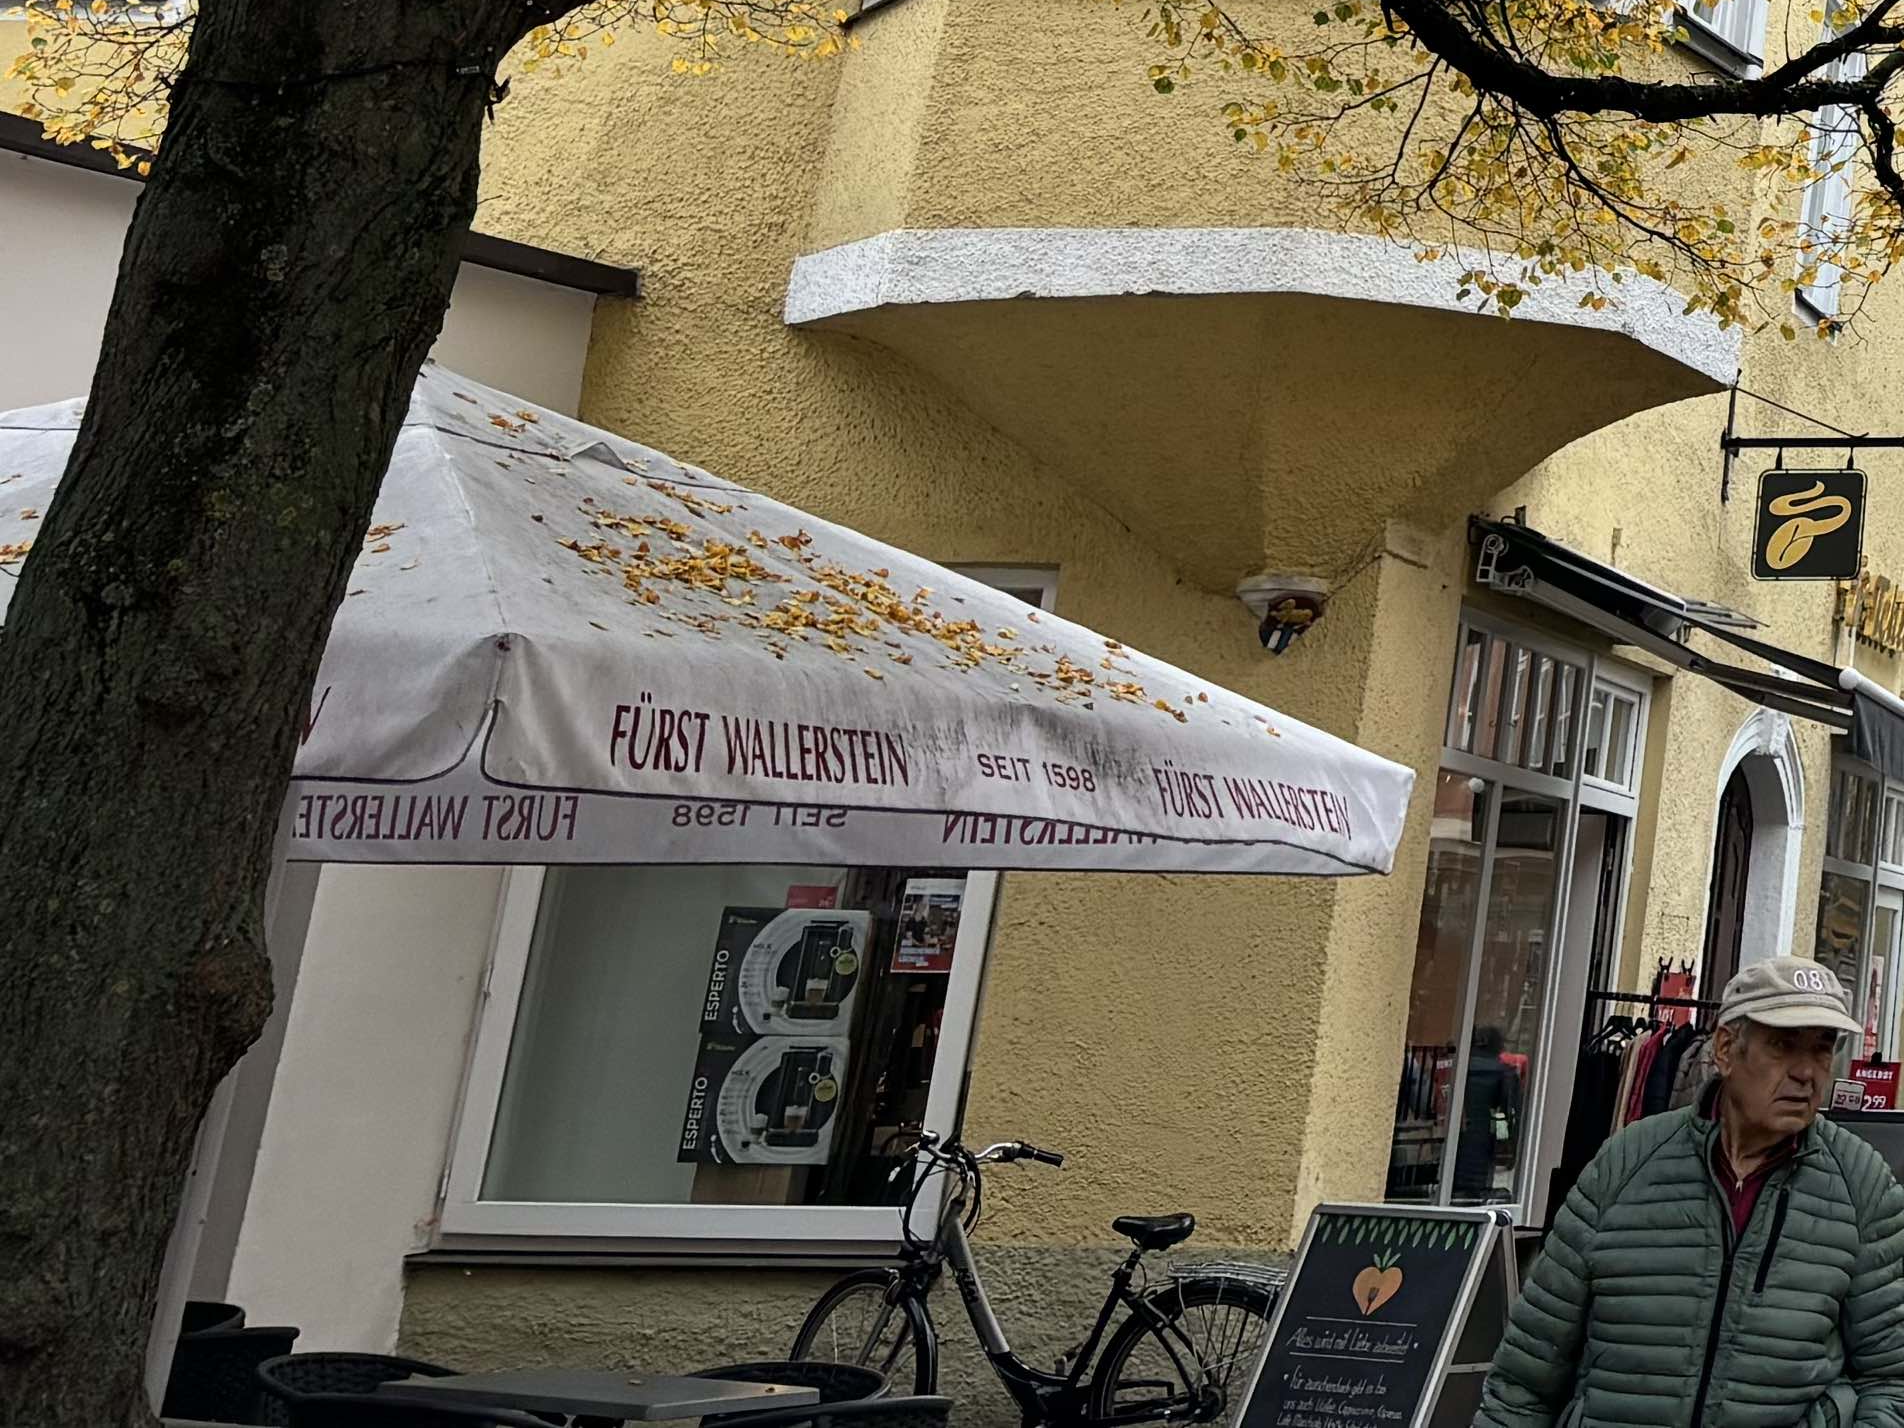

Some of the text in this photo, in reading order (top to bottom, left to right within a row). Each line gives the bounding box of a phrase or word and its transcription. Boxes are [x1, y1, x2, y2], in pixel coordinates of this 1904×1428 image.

[610, 691, 910, 787] FÜRST WALLERSTEIN
[977, 753, 1097, 793] SEIT 1598
[1153, 759, 1354, 841] FÜRST WALLERSTEIN
[704, 949, 730, 1022] ESPERTO
[682, 1076, 708, 1150] ESPERTO
